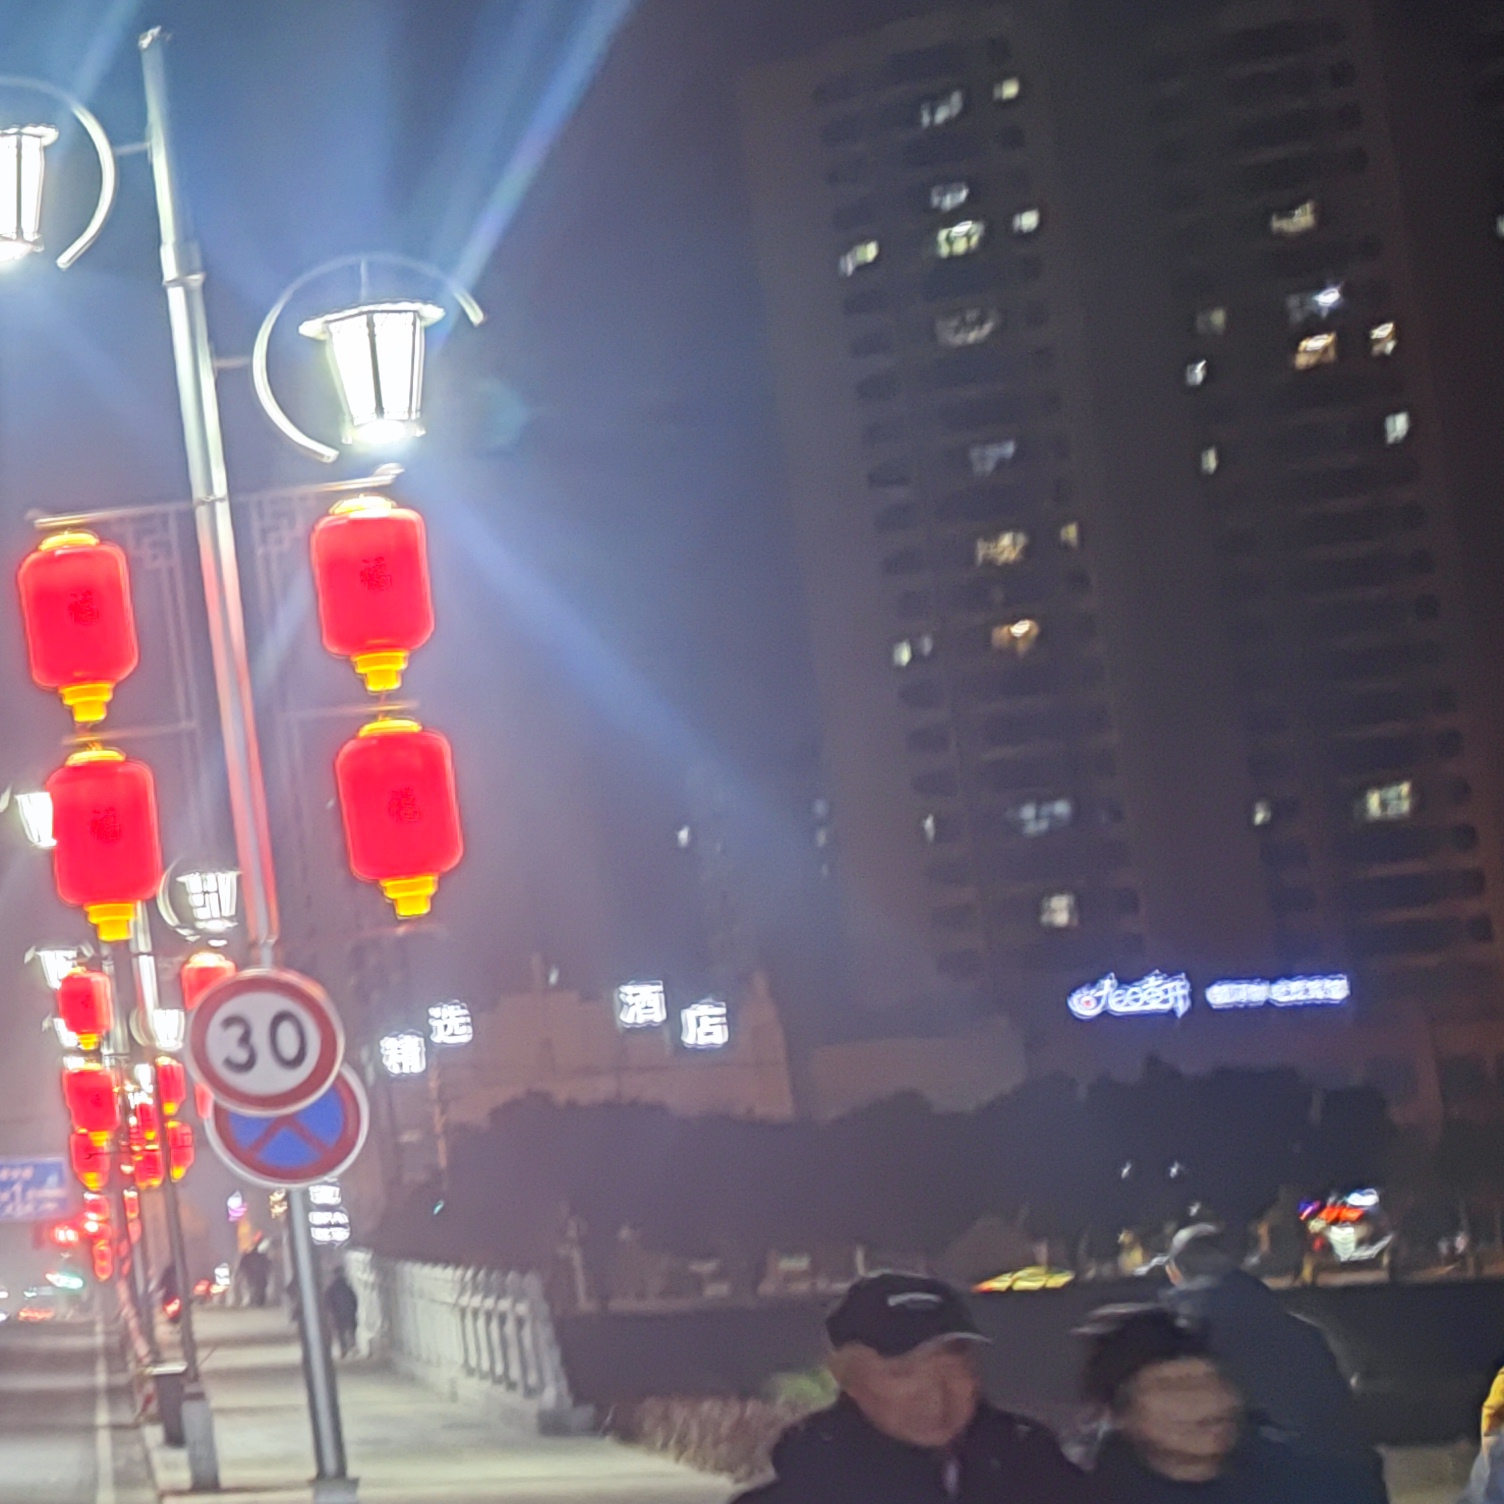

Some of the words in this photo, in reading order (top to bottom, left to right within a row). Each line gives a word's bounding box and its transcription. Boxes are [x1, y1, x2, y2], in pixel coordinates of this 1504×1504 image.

[220, 1010, 307, 1073] 30
[380, 1000, 474, 1076] 精选
[619, 980, 729, 1049] 酒店
